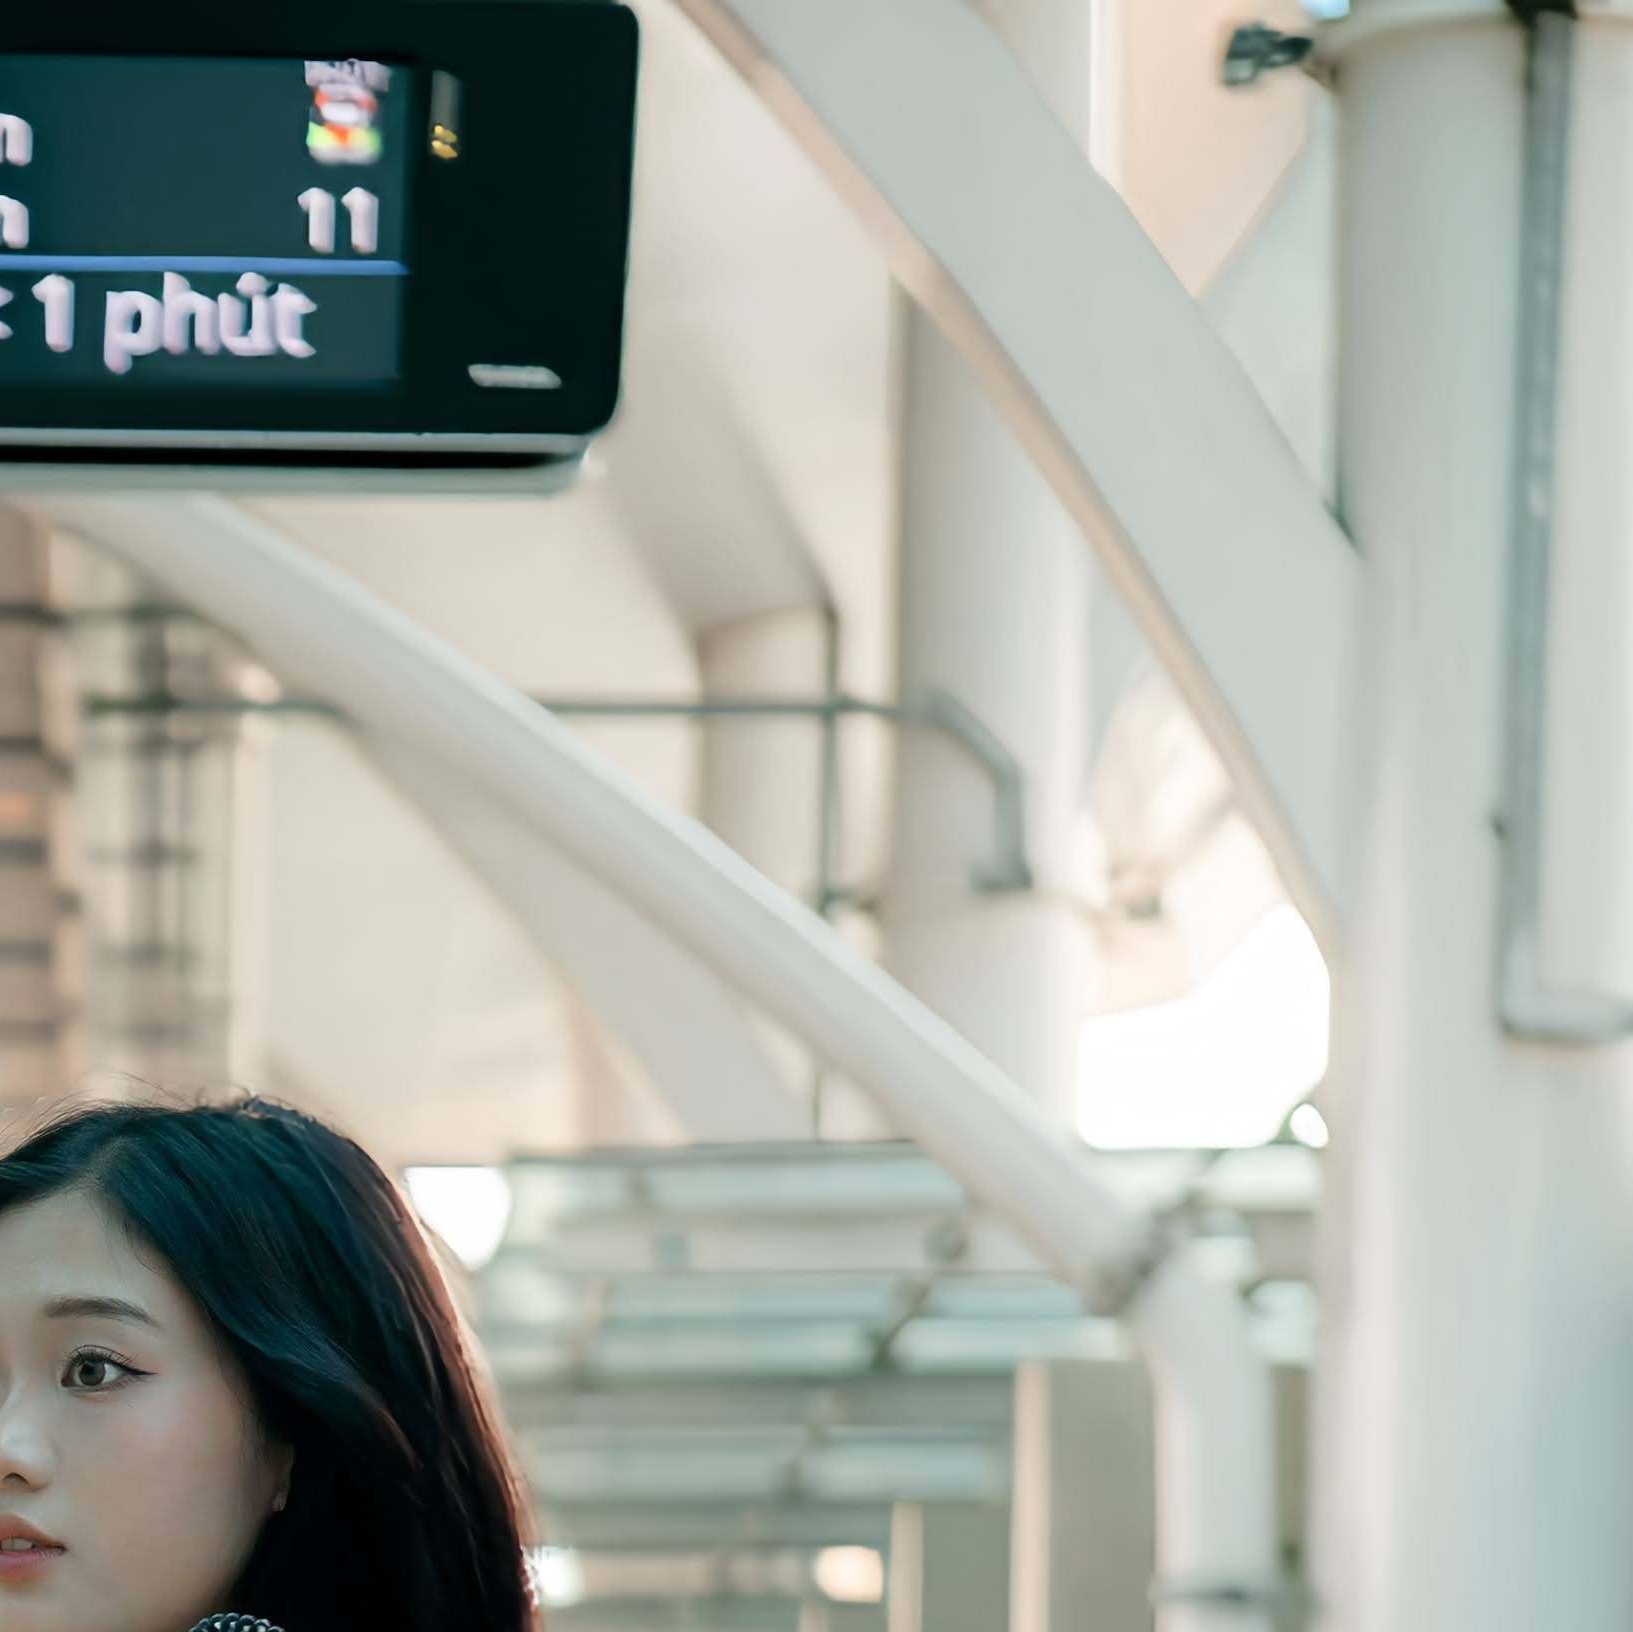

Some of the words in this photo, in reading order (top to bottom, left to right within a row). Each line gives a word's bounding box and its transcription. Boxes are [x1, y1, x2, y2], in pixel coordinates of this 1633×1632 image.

[297, 186, 380, 254] 11
[31, 273, 76, 353] 1
[103, 271, 318, 376] phút
